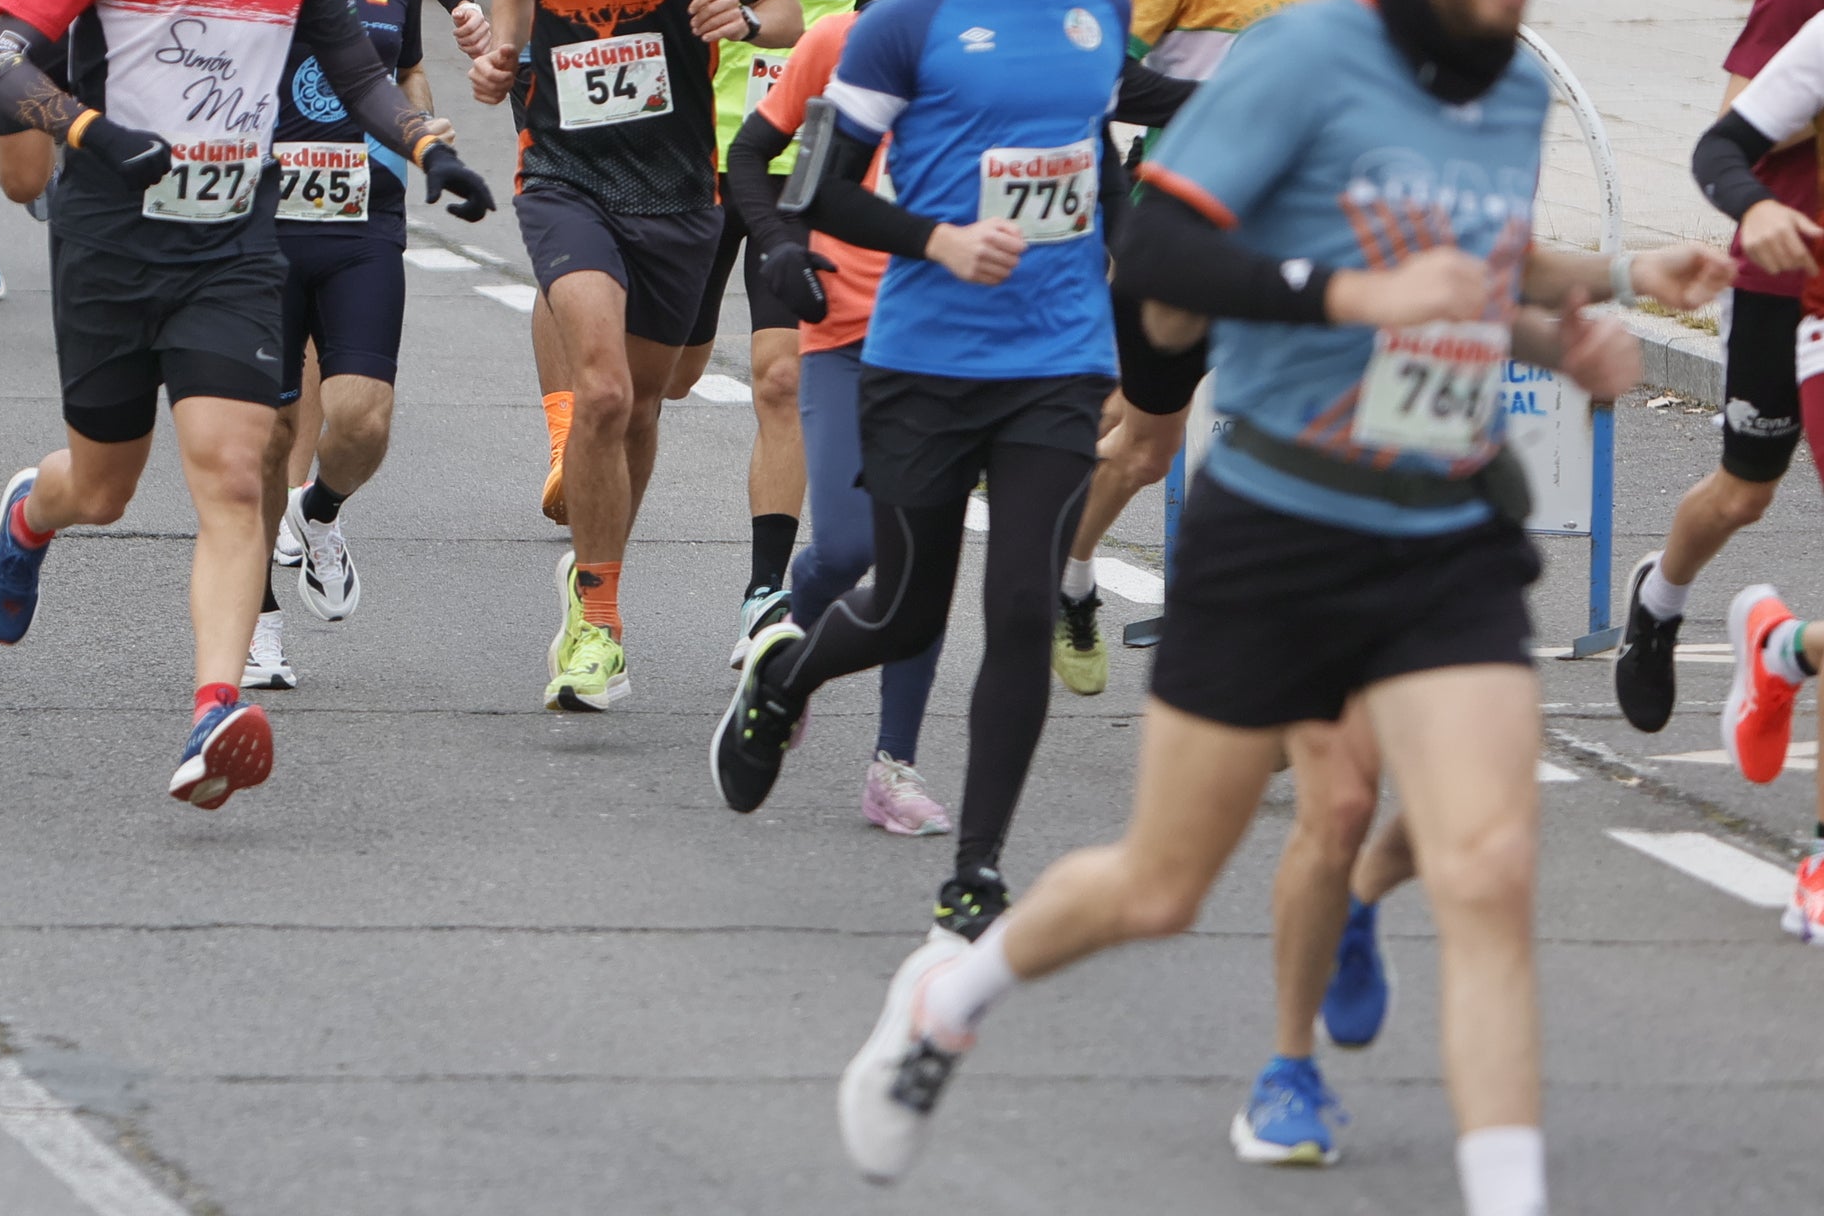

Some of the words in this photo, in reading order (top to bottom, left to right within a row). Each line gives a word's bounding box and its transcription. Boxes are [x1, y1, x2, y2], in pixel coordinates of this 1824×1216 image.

[155, 19, 238, 81] Simón
[557, 40, 662, 72] bedunia
[585, 65, 638, 105] 54
[171, 138, 259, 163] edunia
[279, 149, 366, 169] edunia
[988, 151, 1093, 178] bedunia
[171, 162, 245, 201] 127
[279, 170, 351, 204] 765
[1005, 178, 1080, 220] 776
